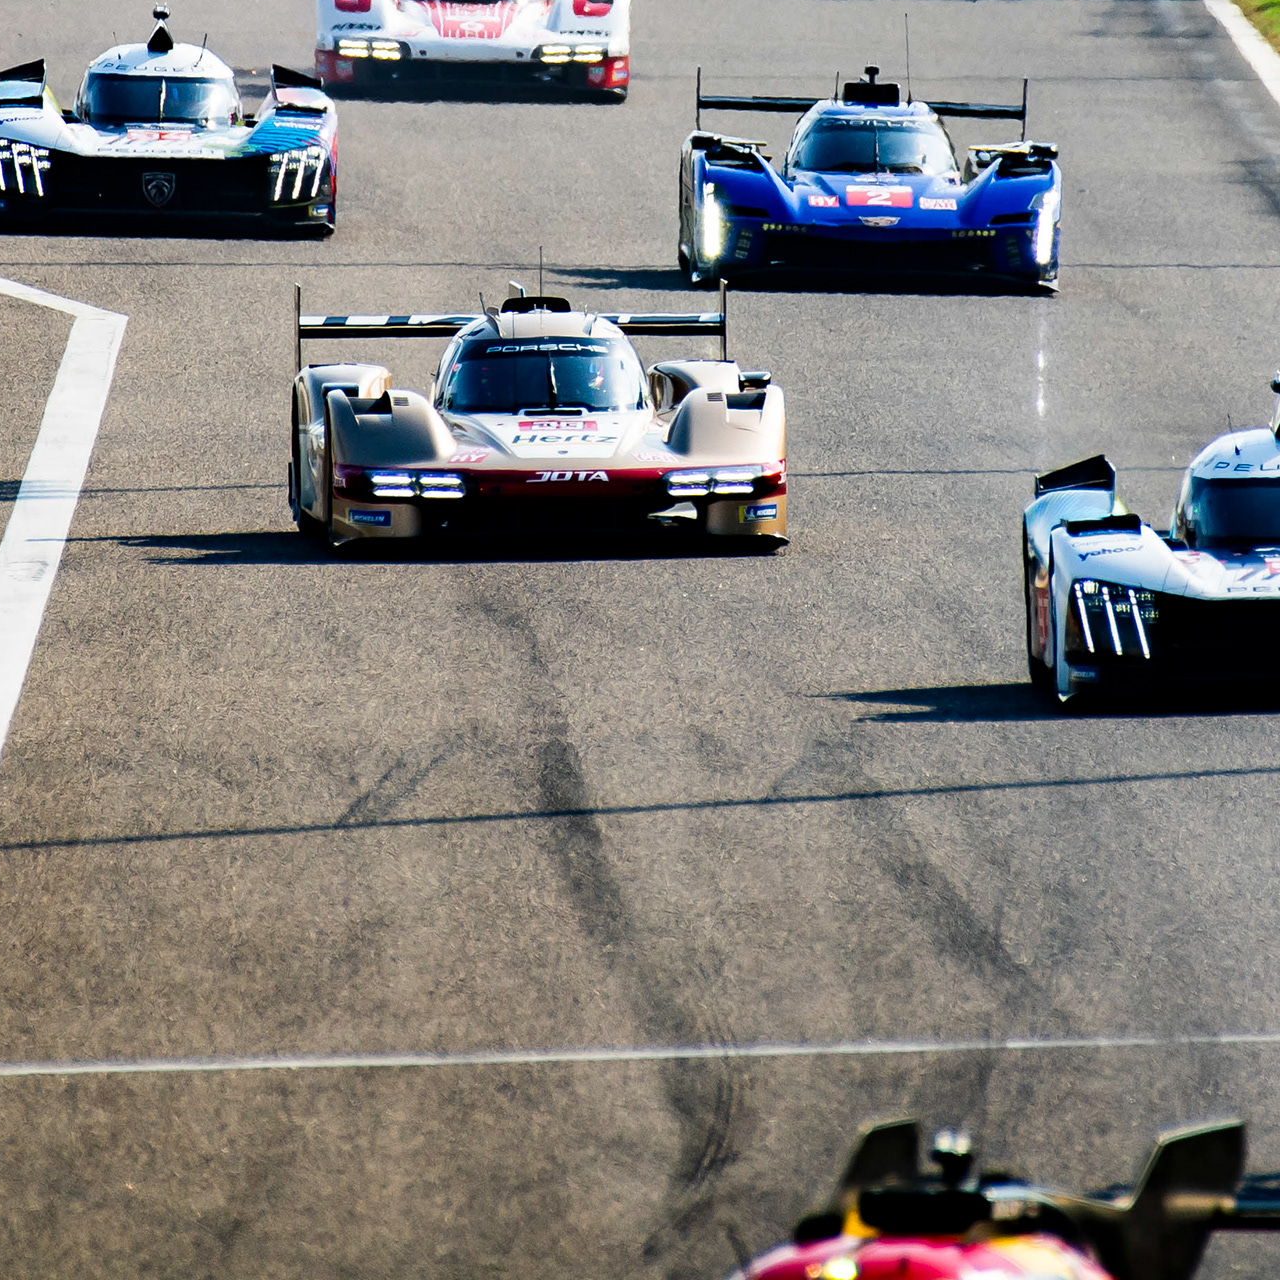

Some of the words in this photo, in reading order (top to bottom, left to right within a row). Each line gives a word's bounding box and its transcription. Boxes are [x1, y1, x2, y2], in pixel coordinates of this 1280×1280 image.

[102, 62, 206, 73] PEUGEO
[866, 190, 893, 206] 2
[486, 342, 610, 354] PORSCHE
[512, 434, 618, 444] Hertz
[526, 471, 609, 483] JOTA
